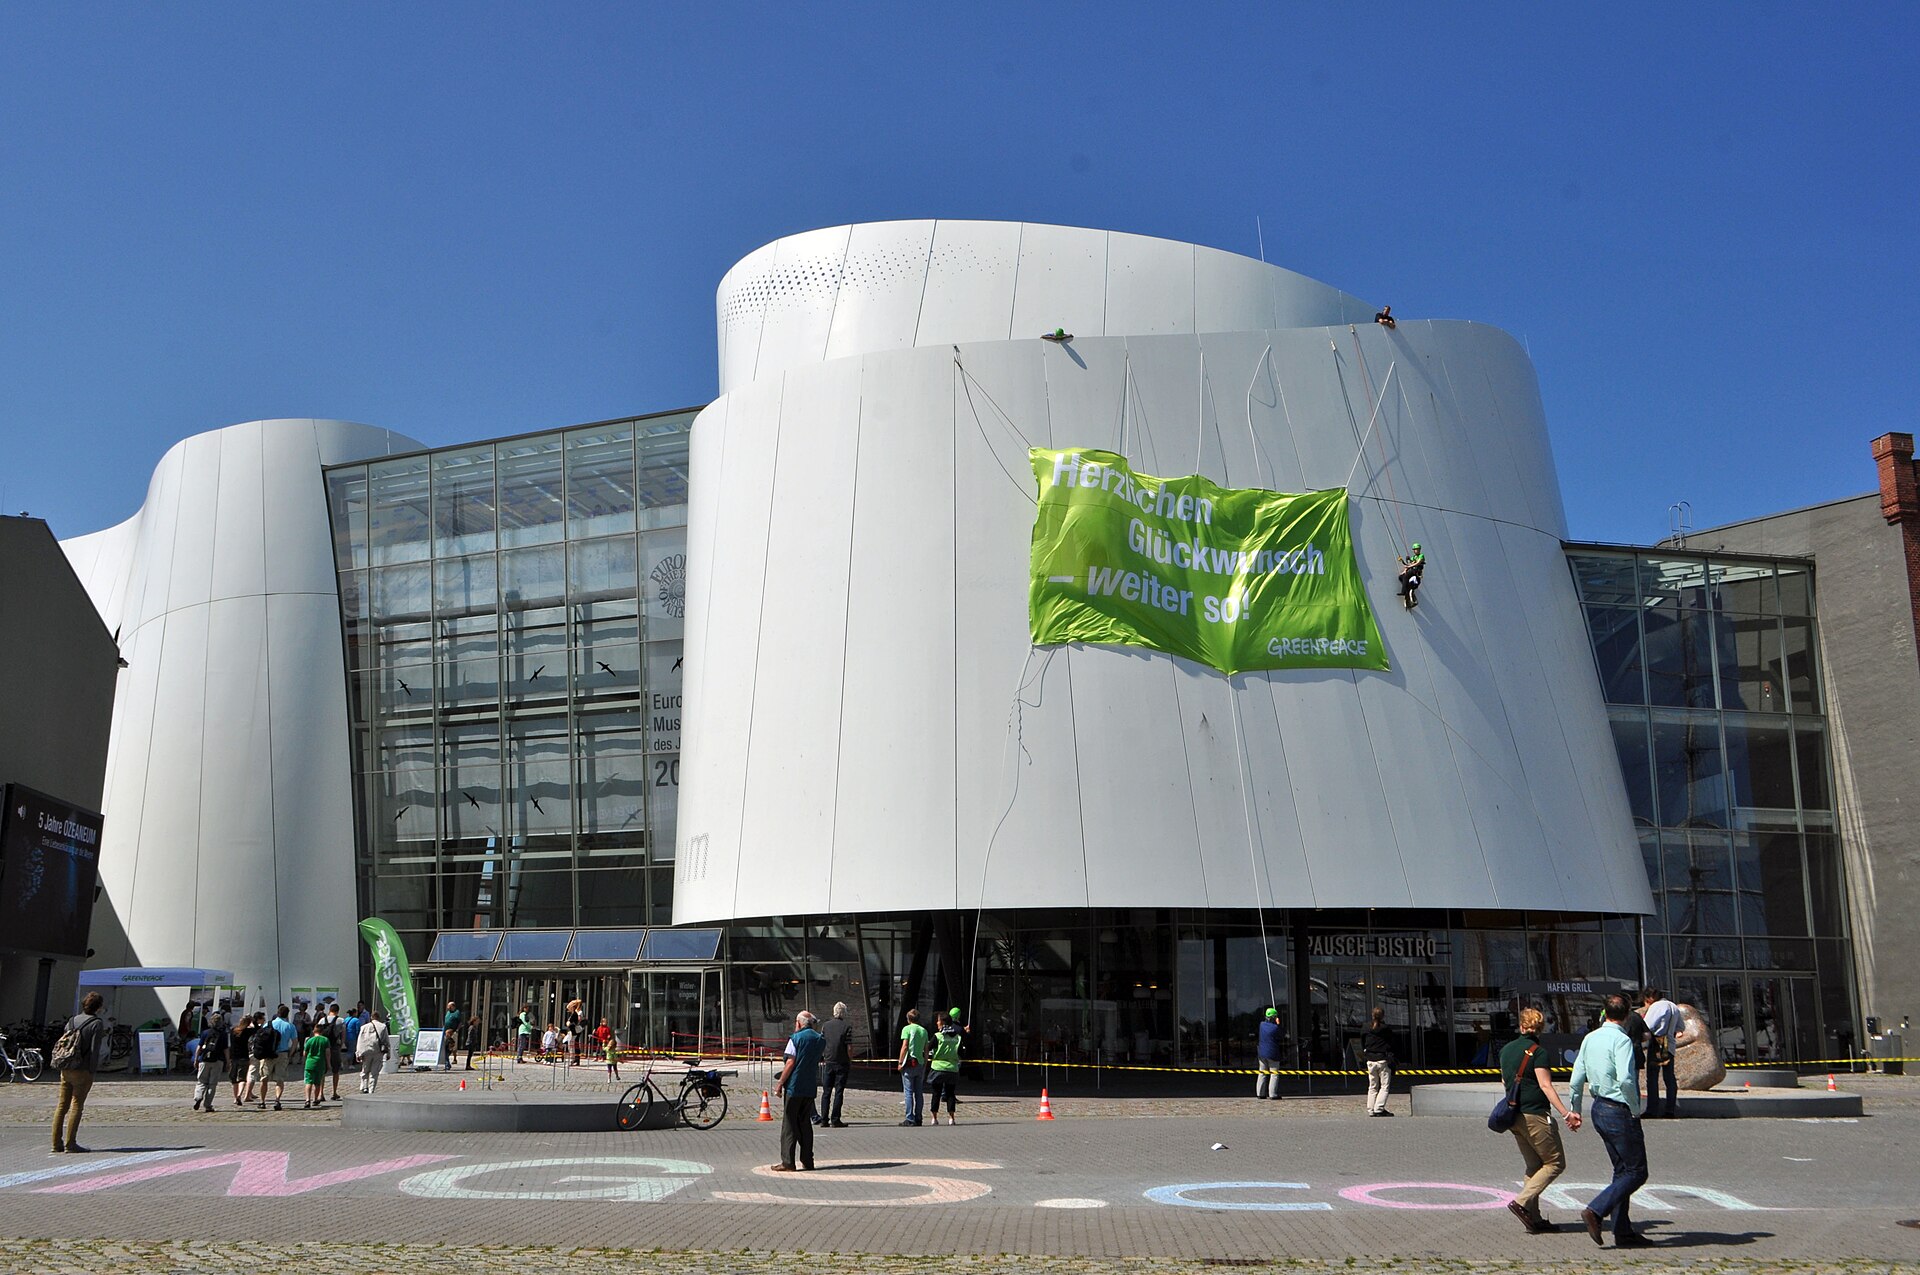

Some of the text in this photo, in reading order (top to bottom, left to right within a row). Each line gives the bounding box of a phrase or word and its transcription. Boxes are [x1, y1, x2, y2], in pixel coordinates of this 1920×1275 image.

[1053, 452, 1212, 525] Herzlichen
[1128, 518, 1324, 576] Glückwunsch
[1204, 587, 1250, 624] so!
[1267, 637, 1369, 659] GREENPEACE
[653, 738, 672, 751] des
[38, 811, 97, 845] 5 Jahre OZEANEUM
[1378, 936, 1437, 957] BISTRO
[121, 975, 165, 983] GREENPEACE
[1546, 982, 1593, 993] HAFEN GRILL
